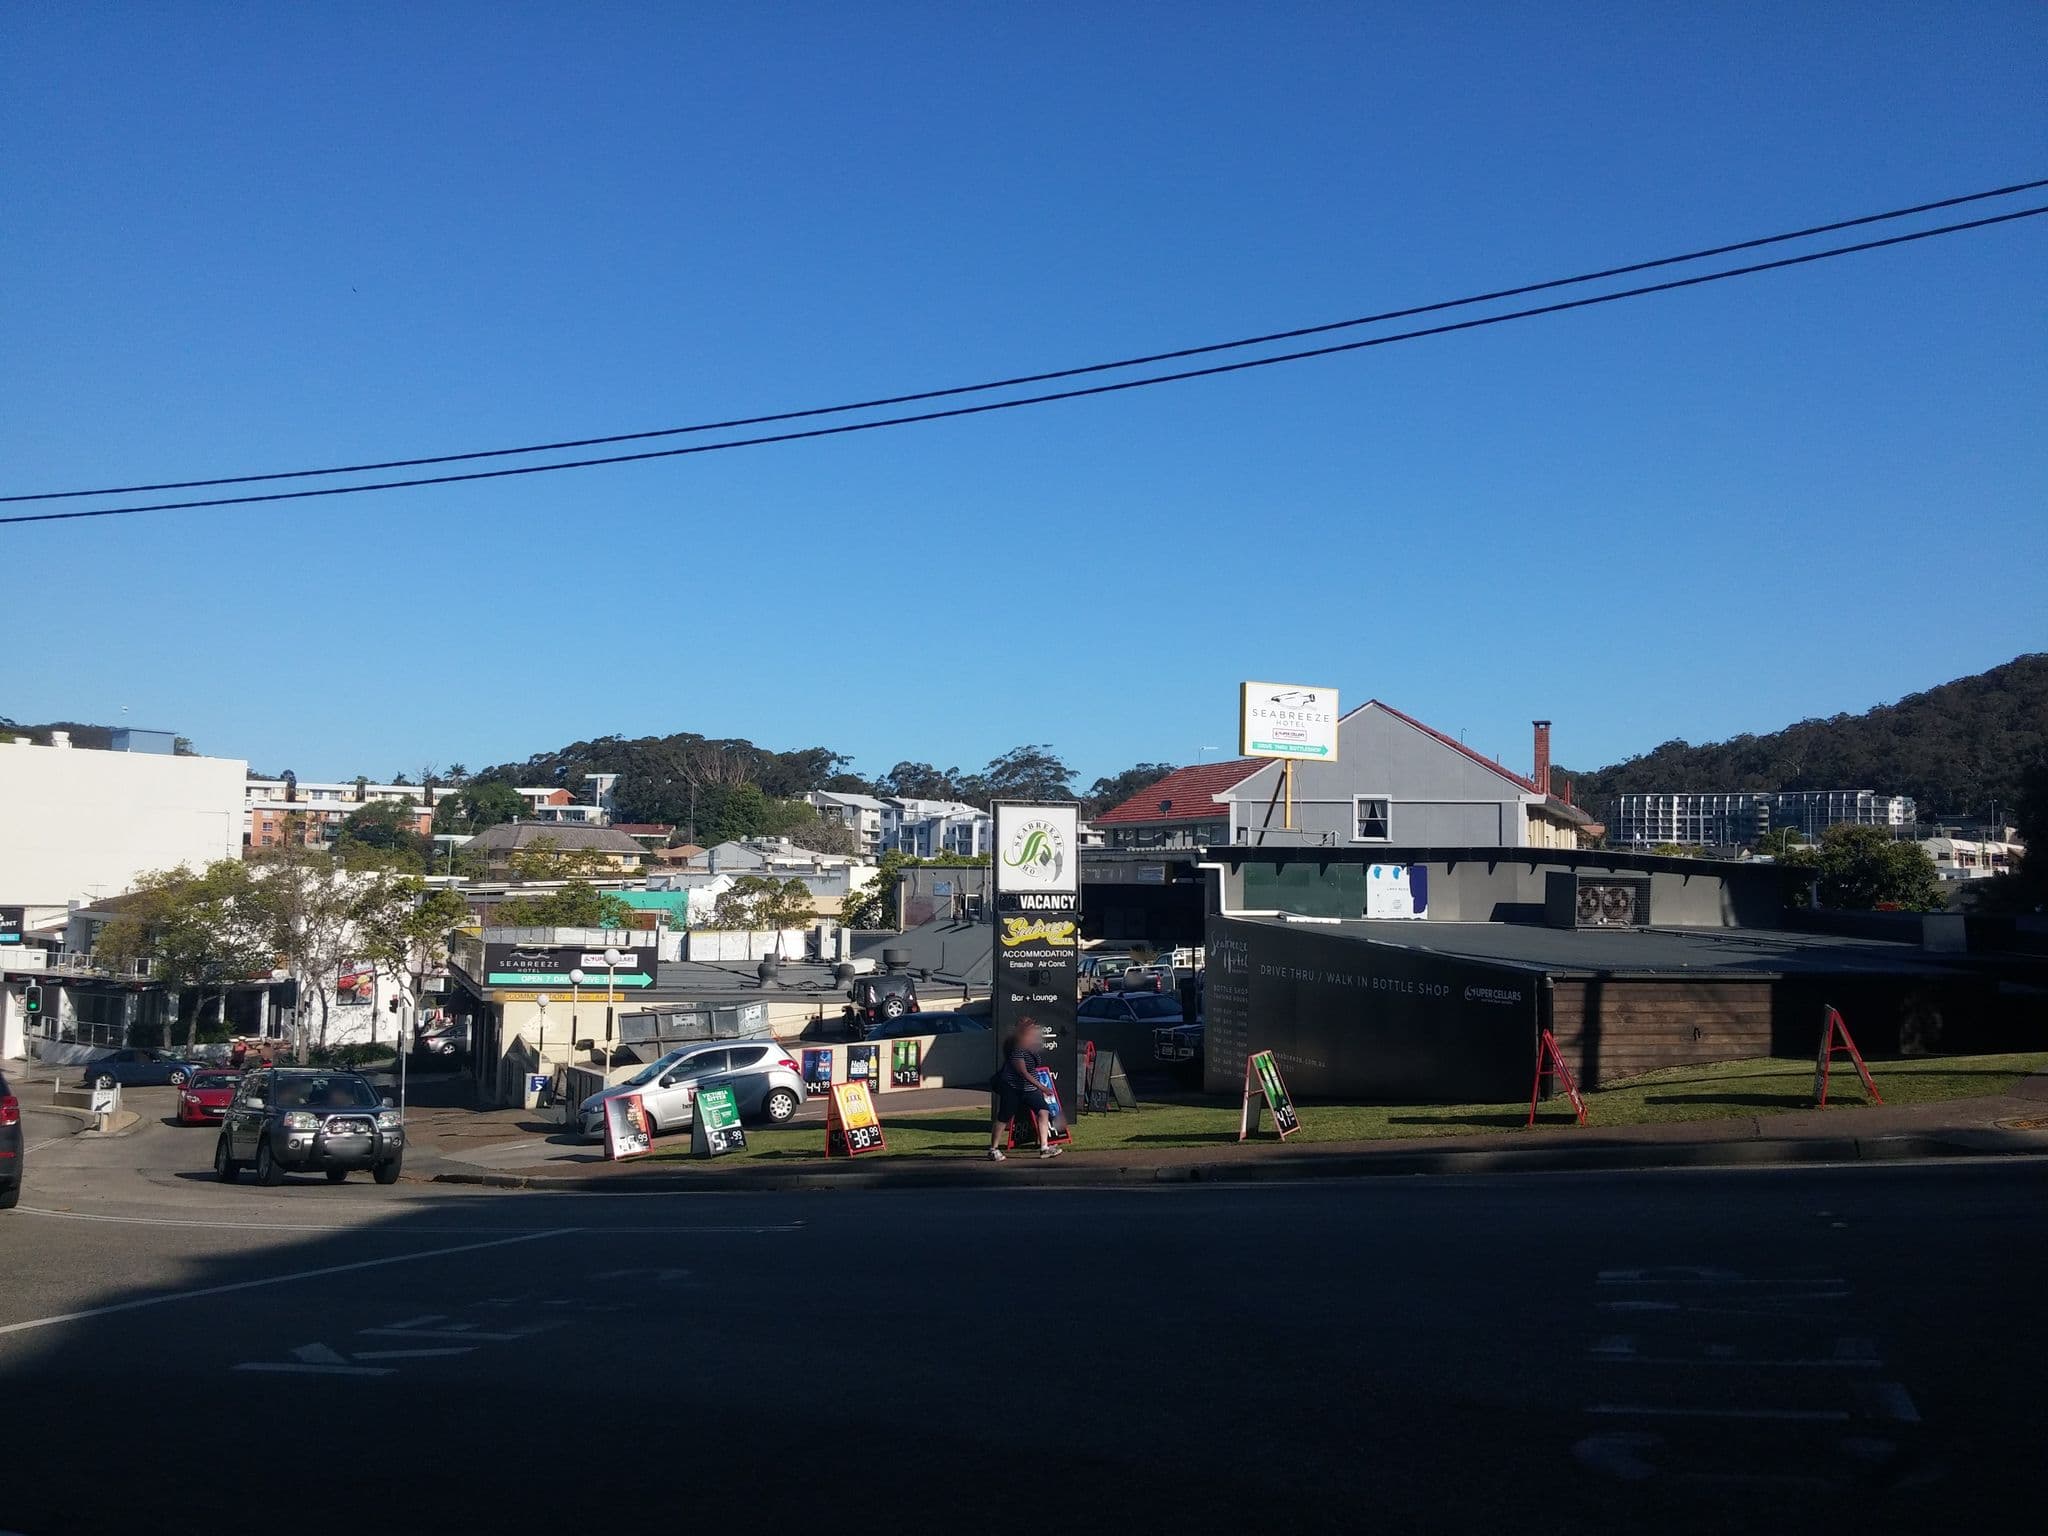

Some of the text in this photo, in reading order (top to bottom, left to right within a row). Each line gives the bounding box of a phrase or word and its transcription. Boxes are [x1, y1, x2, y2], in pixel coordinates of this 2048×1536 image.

[1252, 709, 1329, 723] SEABREEZE
[1276, 720, 1305, 728] HOTEL
[1014, 822, 1063, 847] SEABREEZE
[1020, 894, 1076, 910] VACANCY
[1002, 950, 1074, 958] ACCOMMODATION
[499, 960, 560, 968] SEABREEZE
[1009, 960, 1034, 968] Ensuite
[521, 975, 543, 983] OPEN
[1260, 963, 1287, 979] DRIVE
[1290, 968, 1314, 982] THRU
[1326, 972, 1353, 986] WALK
[1357, 976, 1368, 987] IN
[1372, 977, 1413, 993] BOTTLE
[1418, 982, 1450, 997] SHOP
[1011, 993, 1024, 1002] Bar
[1033, 993, 1058, 1003] Lounge
[851, 1060, 868, 1068] Hello
